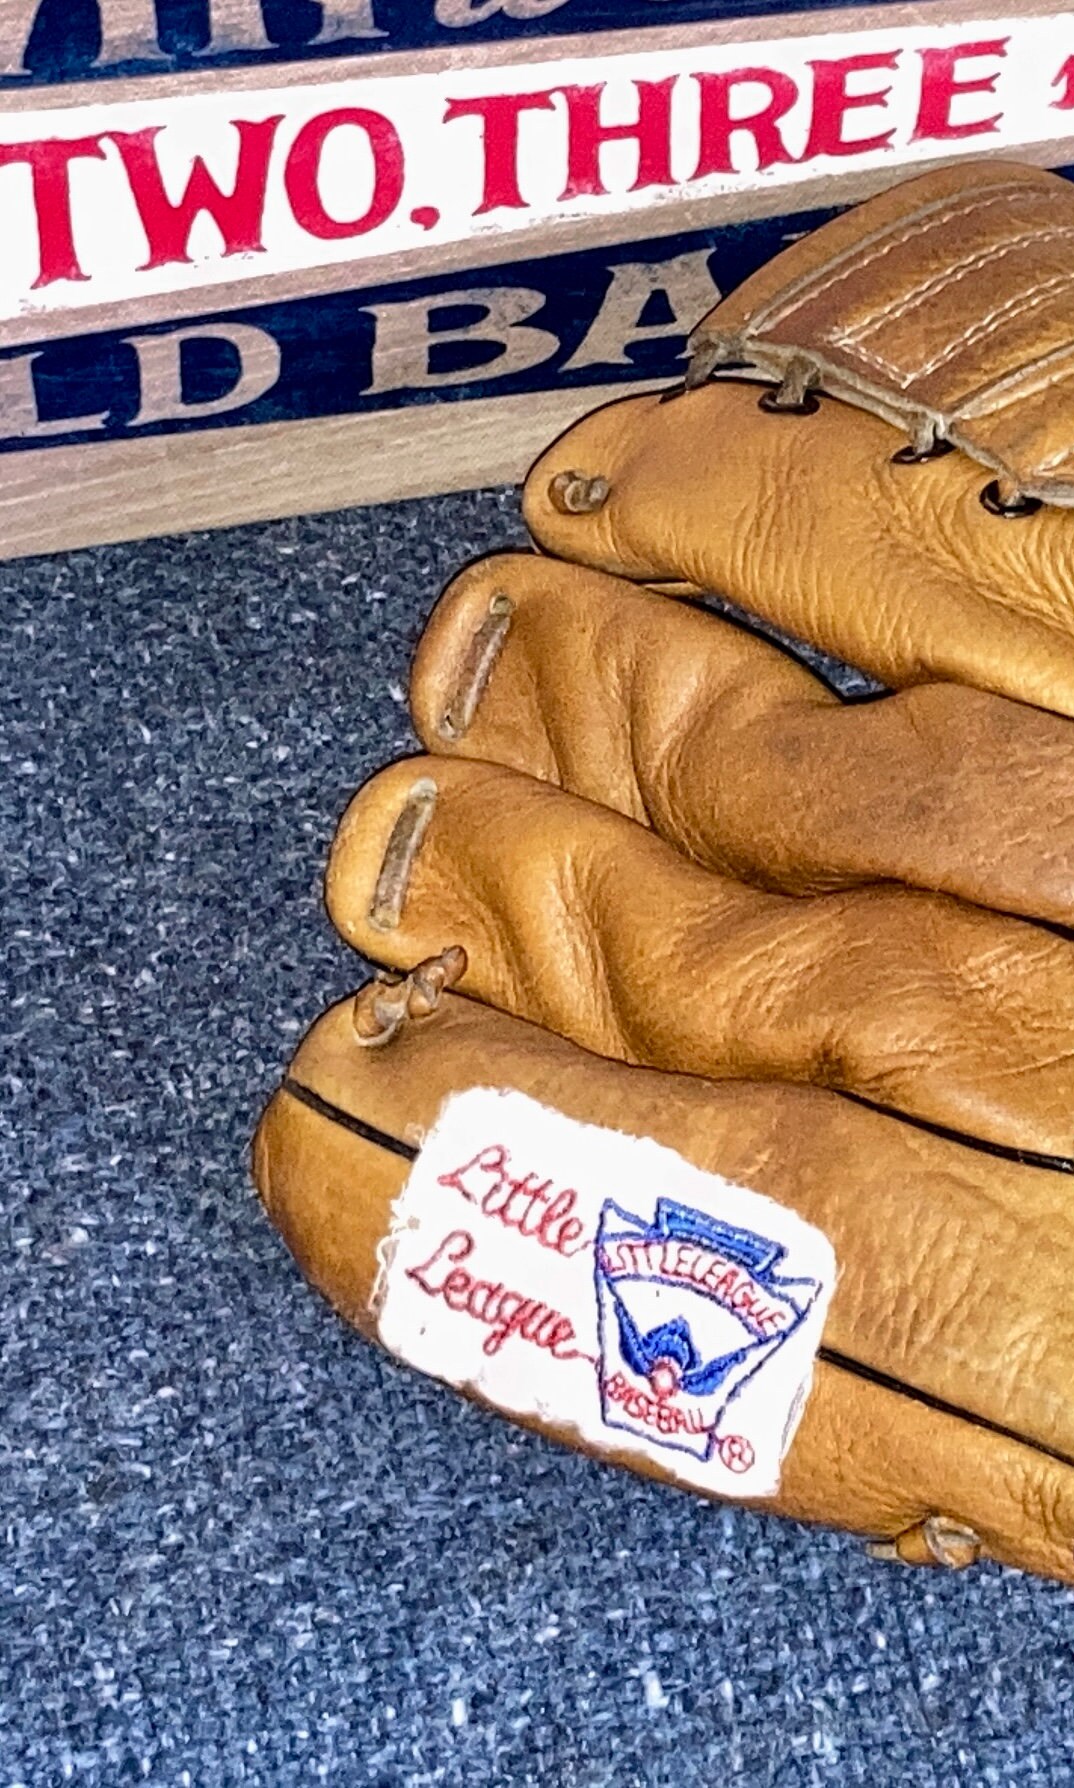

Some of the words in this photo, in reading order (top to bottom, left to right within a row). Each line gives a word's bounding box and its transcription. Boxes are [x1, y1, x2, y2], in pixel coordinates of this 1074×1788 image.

[443, 36, 1011, 215] THREE
[359, 232, 730, 396] BA
[437, 1144, 590, 1257] Little
[406, 1229, 592, 1358] League
